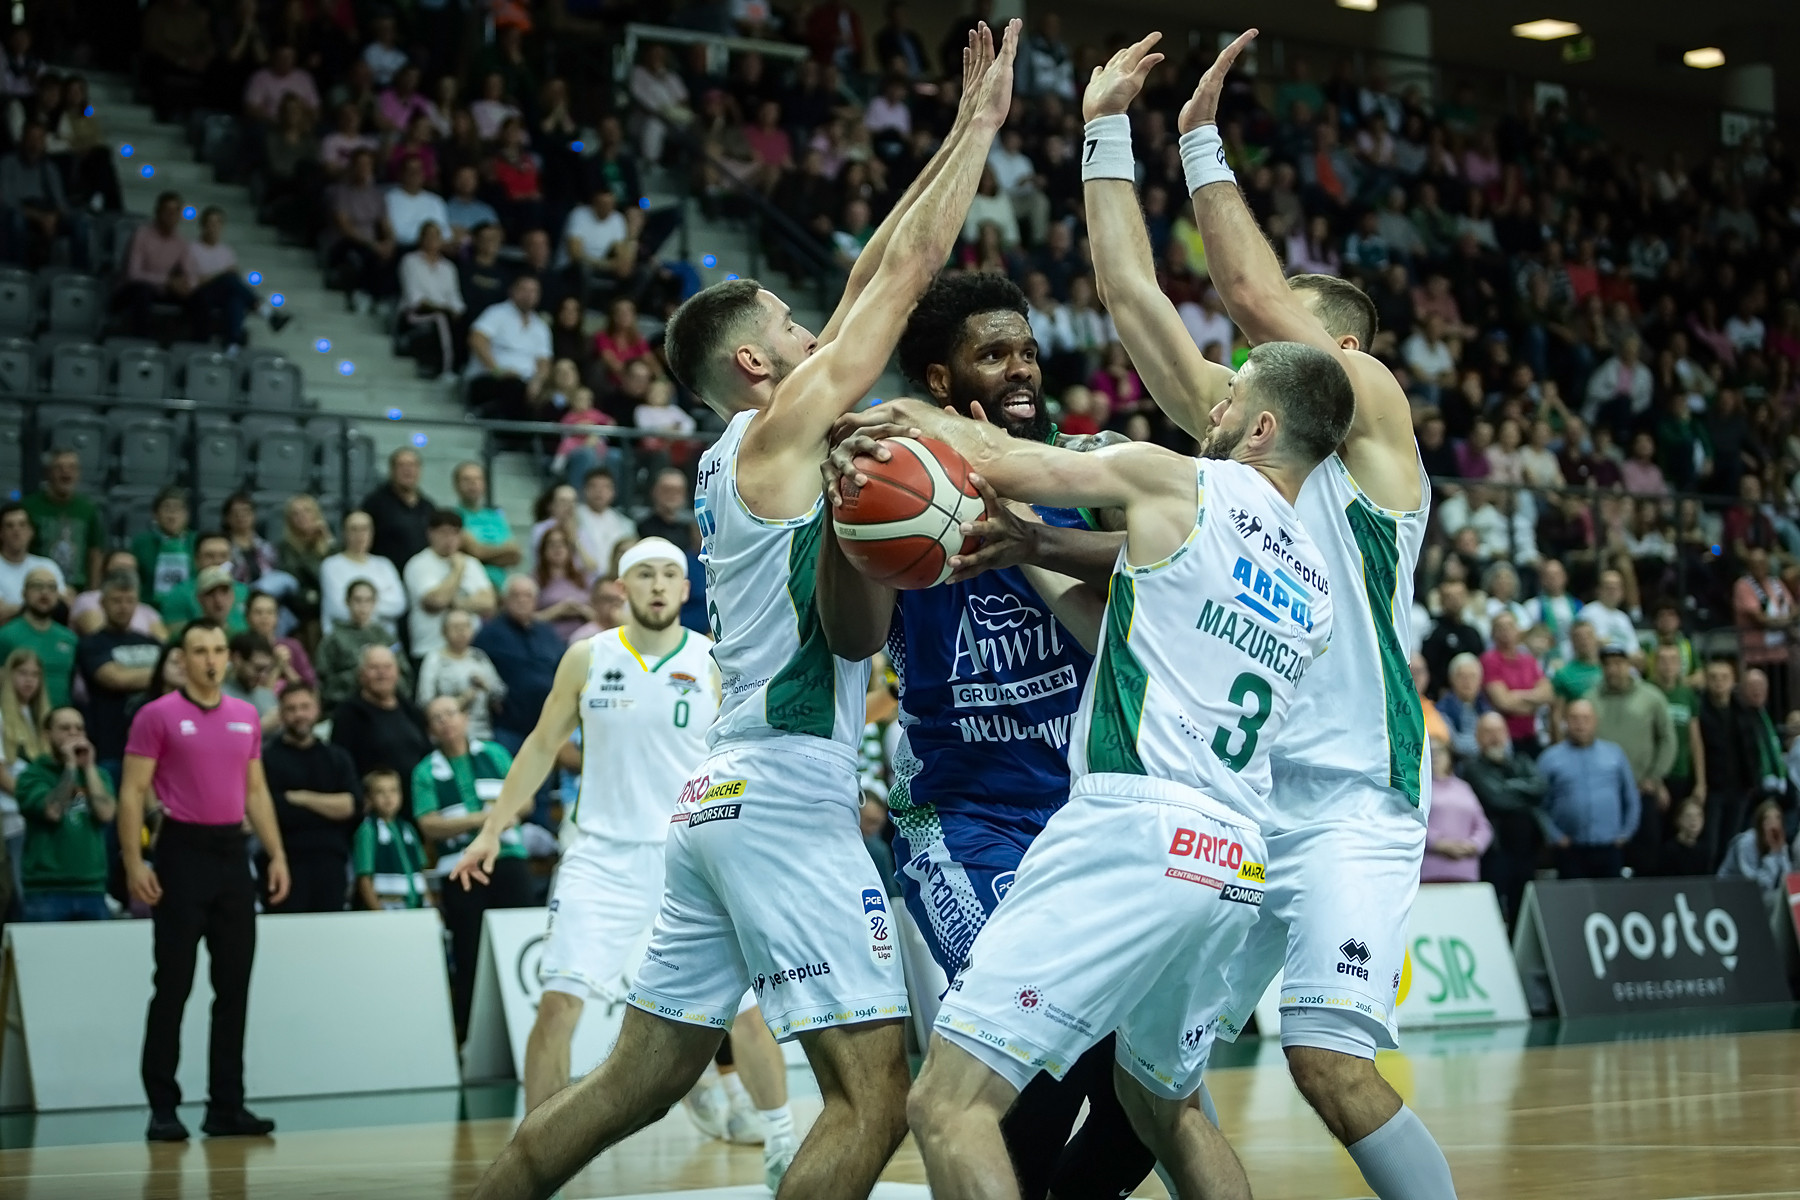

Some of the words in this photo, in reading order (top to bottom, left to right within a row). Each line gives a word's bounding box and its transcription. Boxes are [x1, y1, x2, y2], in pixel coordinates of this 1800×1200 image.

[1086, 139, 1099, 163] 7
[1262, 533, 1329, 596] perceptus
[947, 606, 1064, 682] Anwil
[1196, 599, 1305, 690] MAZURCZA
[1015, 669, 1074, 699] ORLEN
[674, 700, 689, 728] 0
[1211, 672, 1272, 774] 3
[1168, 827, 1243, 870] BRICO
[999, 881, 1015, 893] PG
[865, 896, 882, 906] PGE
[872, 944, 893, 952] Basket
[878, 952, 891, 960] Liga
[1336, 961, 1369, 982] errea
[1612, 977, 1726, 1001] DEVELOPMENT
[658, 1005, 684, 1018] 2026
[709, 1016, 727, 1026] 202
[812, 1011, 834, 1025] 1946
[855, 1005, 878, 1018] 1946
[1299, 994, 1324, 1005] 2026
[1355, 1001, 1372, 1015] 2026
[977, 1029, 1006, 1048] 2026
